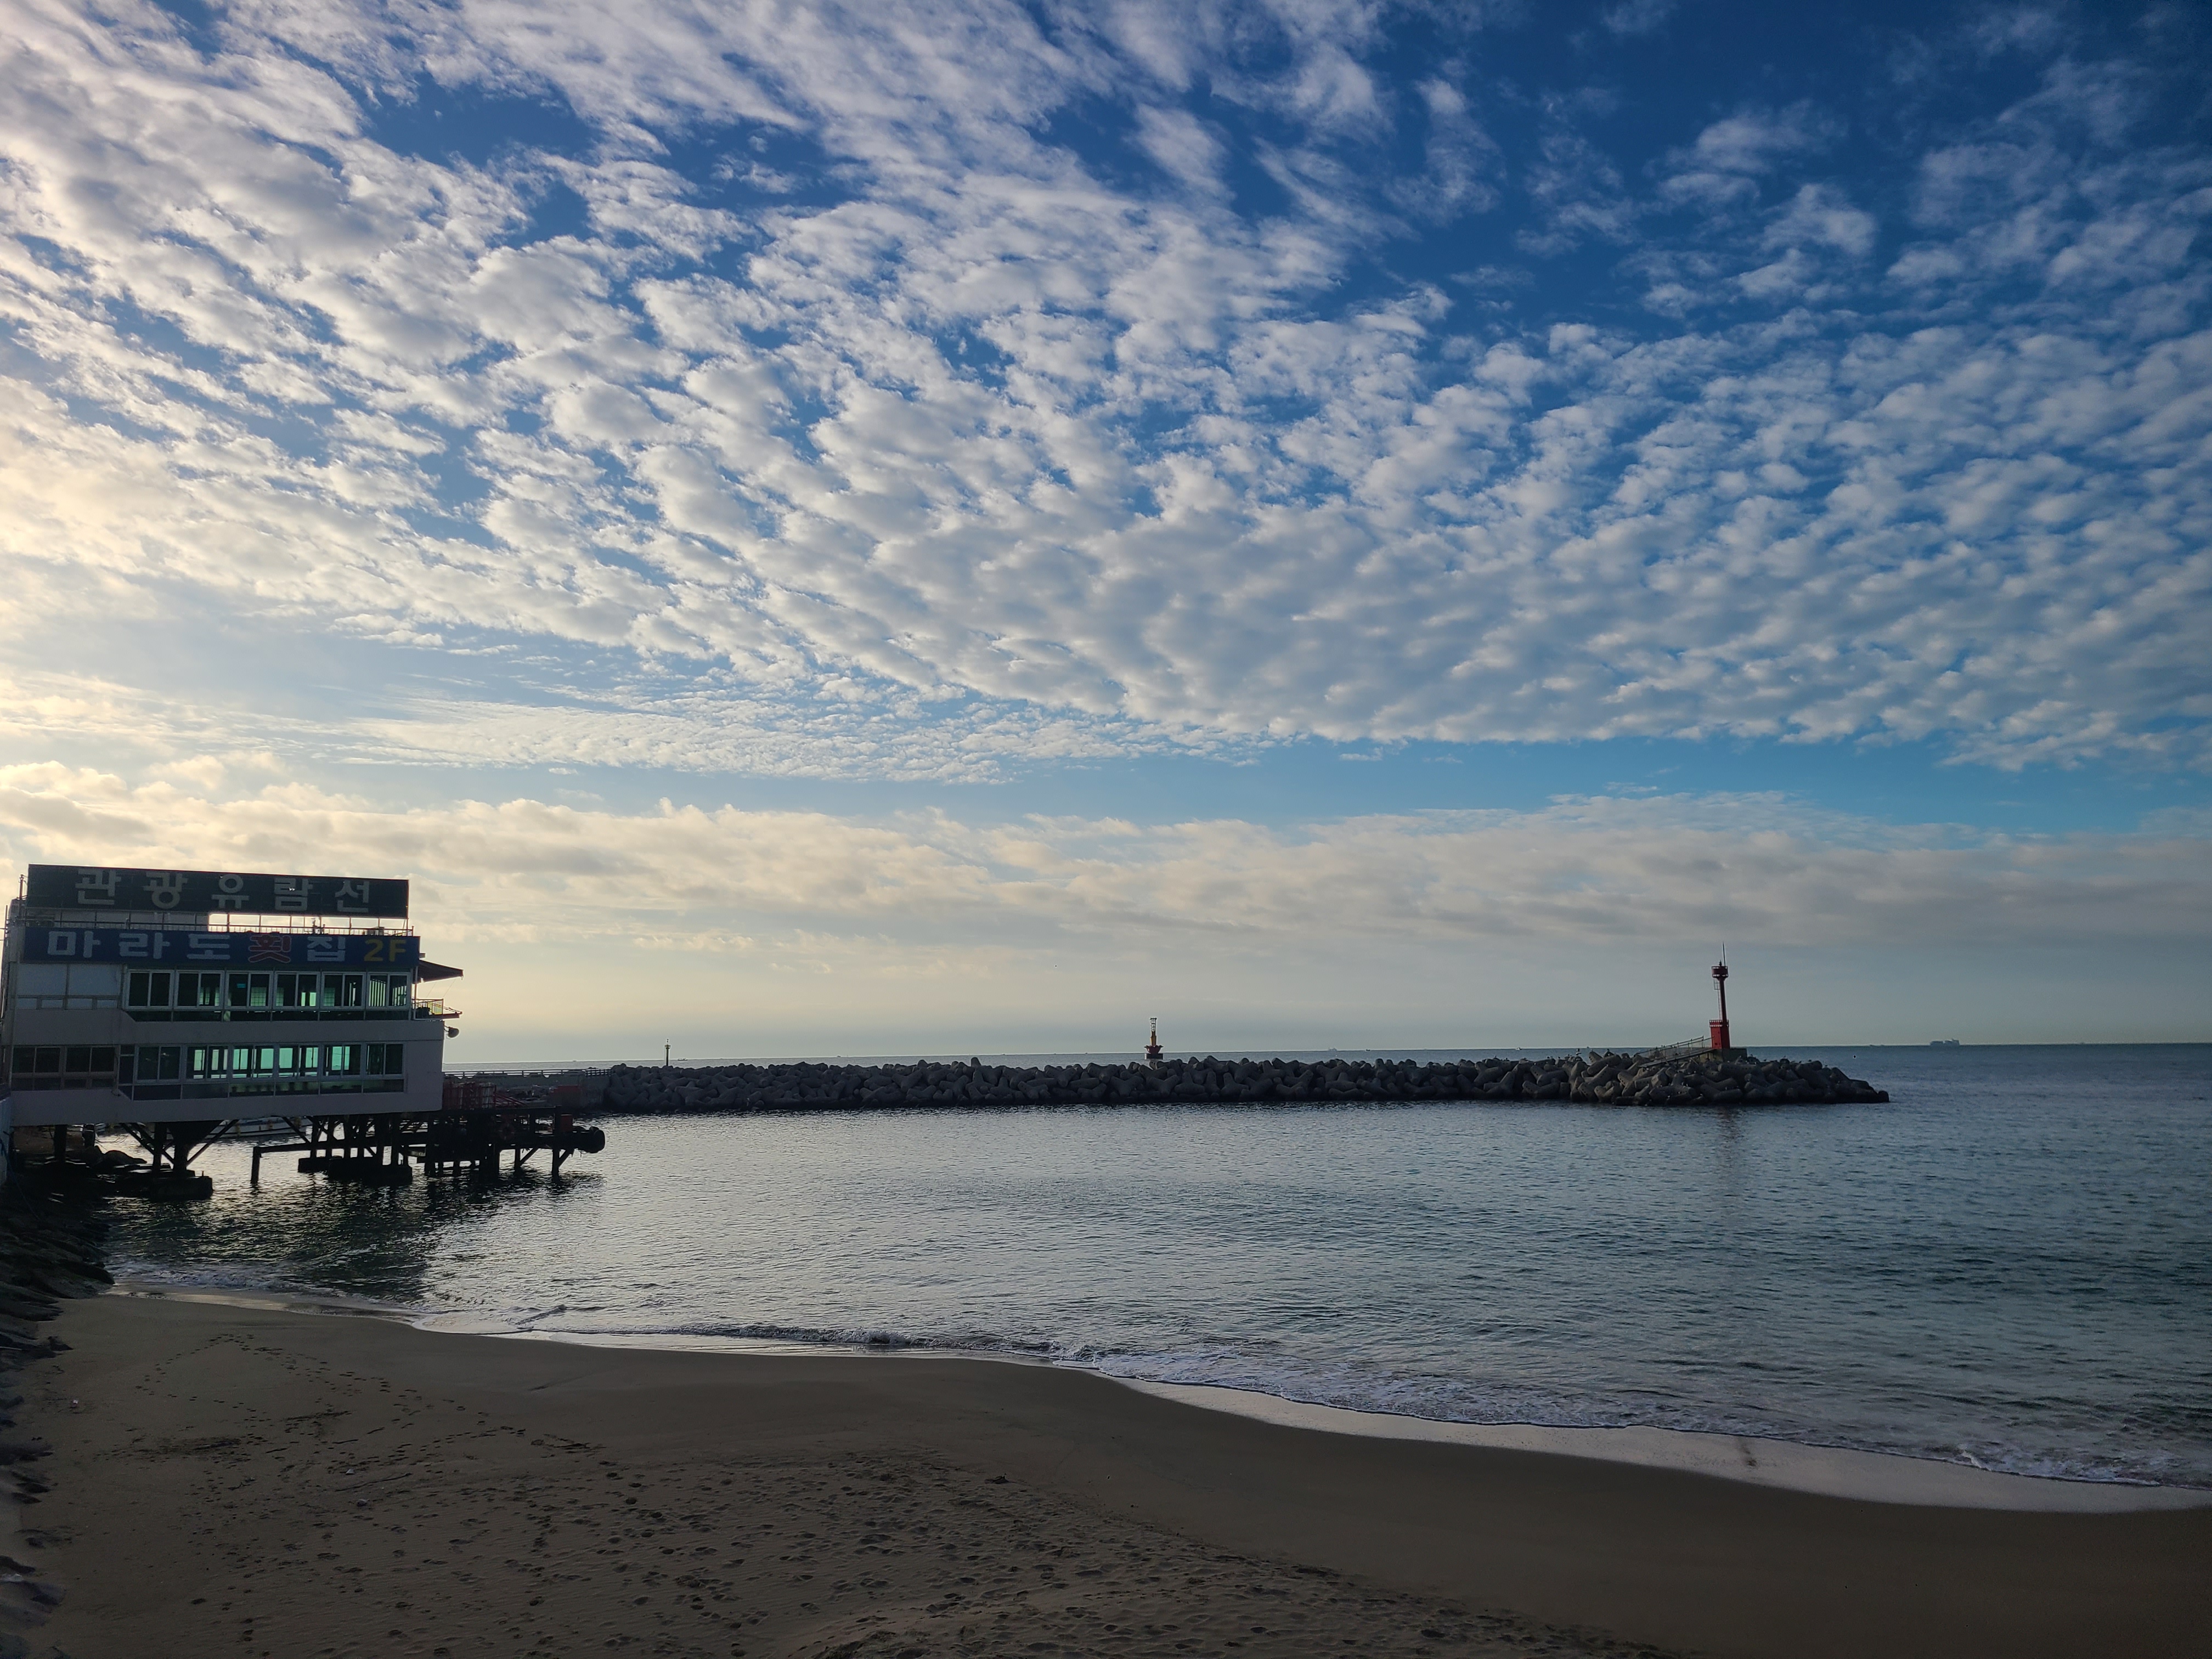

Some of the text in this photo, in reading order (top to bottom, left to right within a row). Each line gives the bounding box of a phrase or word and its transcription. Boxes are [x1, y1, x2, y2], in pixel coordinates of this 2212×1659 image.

[75, 868, 370, 913] 관광유람선
[47, 930, 407, 963] 마라도횟집 2F
